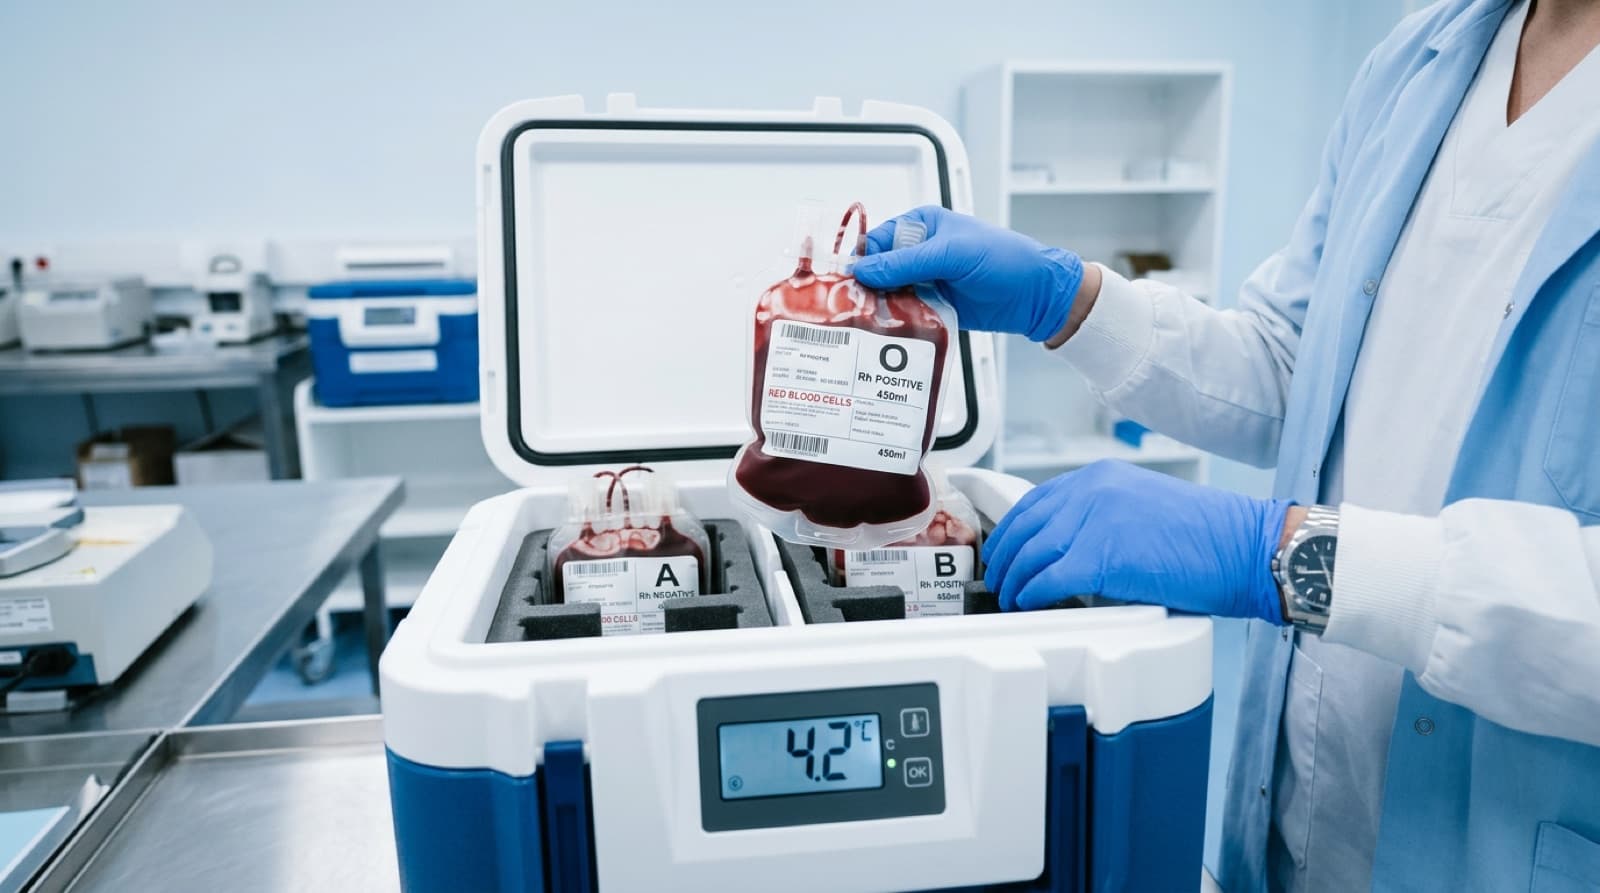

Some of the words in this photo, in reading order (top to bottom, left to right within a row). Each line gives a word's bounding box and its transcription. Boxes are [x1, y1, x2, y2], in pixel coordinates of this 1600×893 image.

[879, 343, 909, 373] O
[857, 372, 872, 383] Rh
[875, 374, 924, 391] POSITIVE
[768, 388, 787, 398] RED
[788, 390, 821, 402] BLOOD
[822, 395, 852, 407] CELLS
[876, 389, 908, 403] 450ml
[877, 447, 907, 460] 450ml
[934, 552, 957, 577] B
[655, 563, 680, 587] A
[934, 580, 964, 589] POSITI
[786, 721, 851, 781] 4.2
[908, 766, 928, 779] OK
